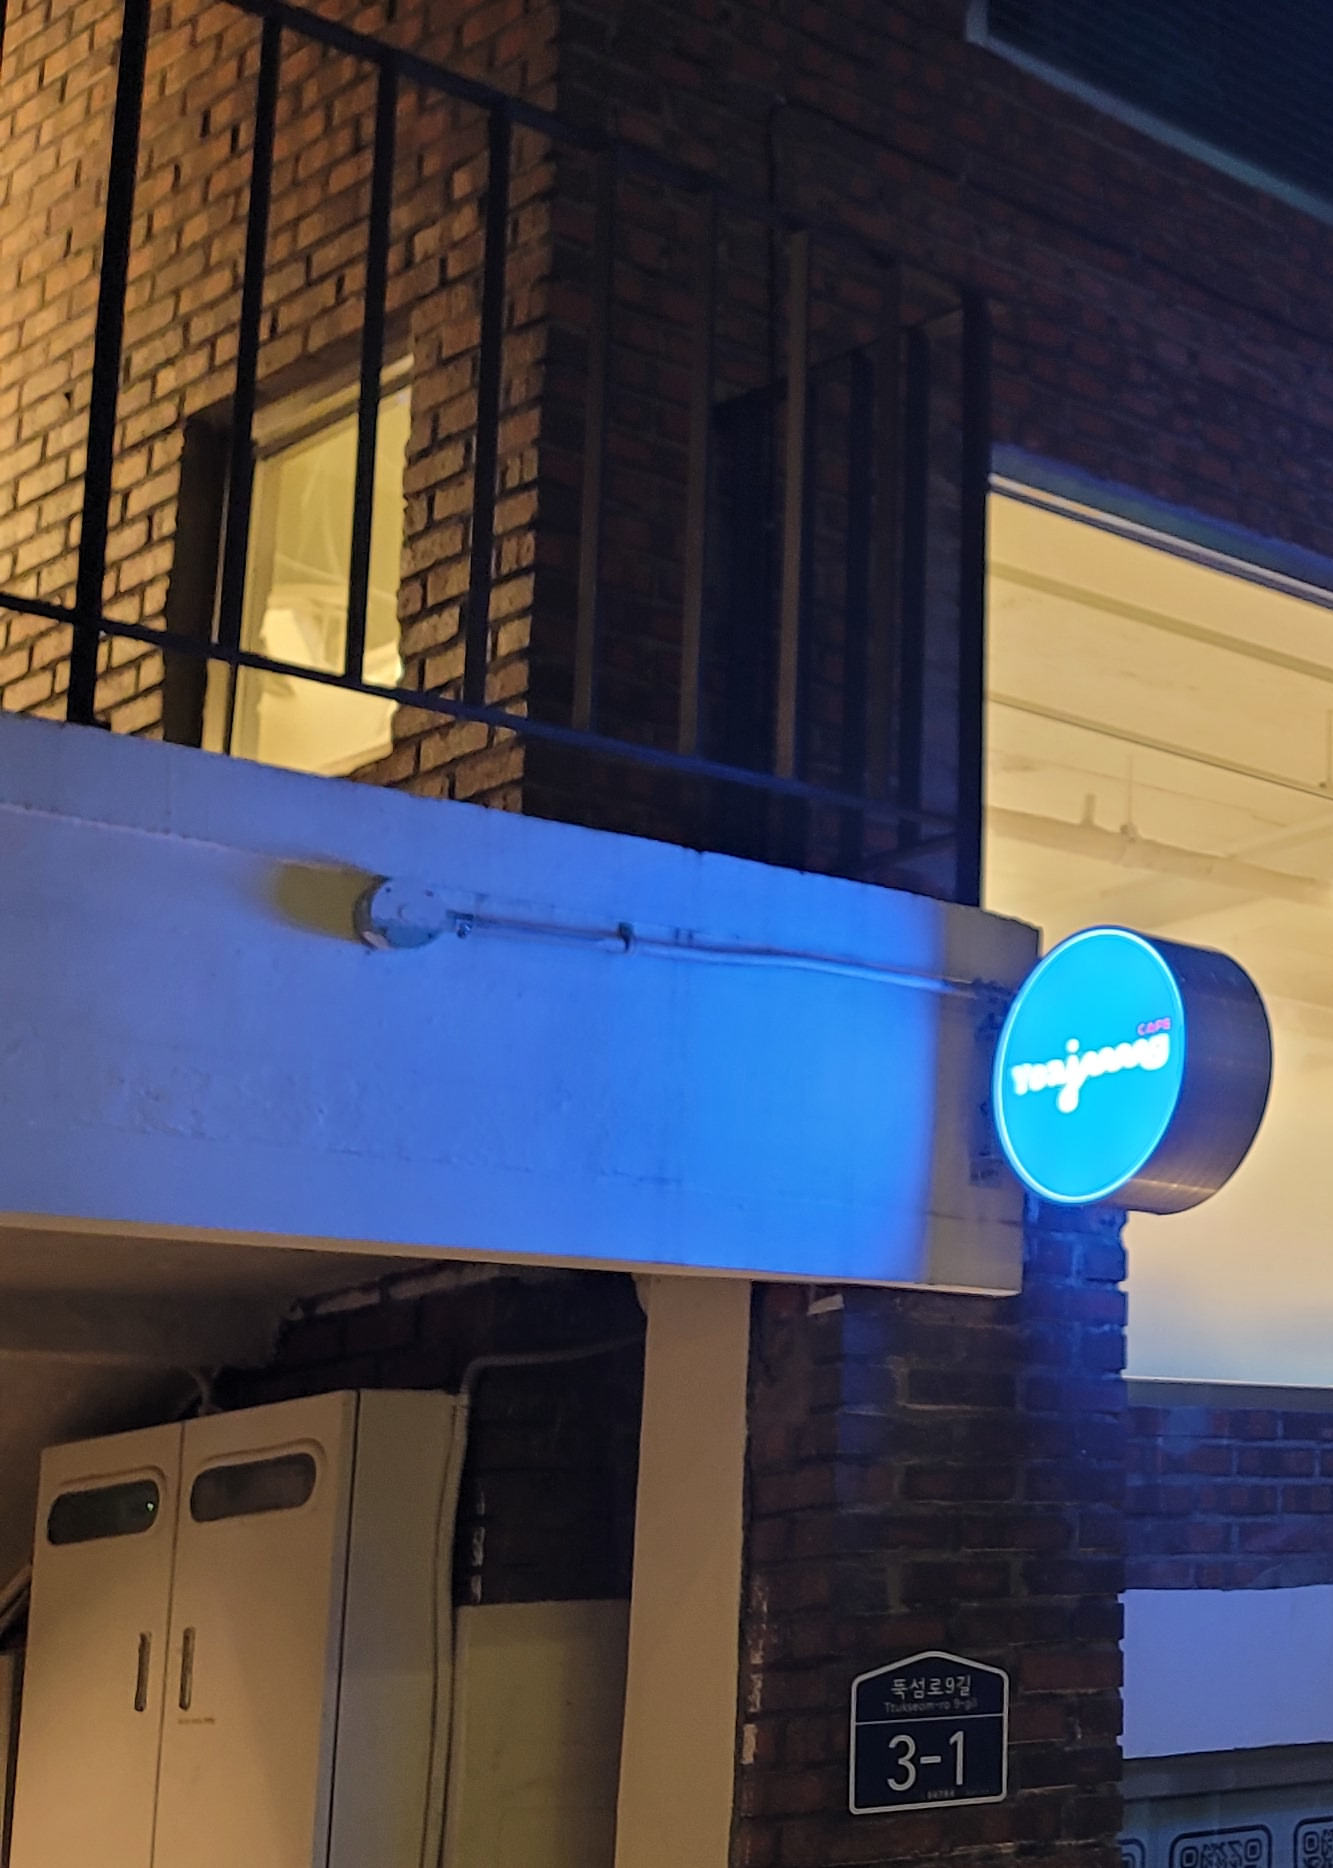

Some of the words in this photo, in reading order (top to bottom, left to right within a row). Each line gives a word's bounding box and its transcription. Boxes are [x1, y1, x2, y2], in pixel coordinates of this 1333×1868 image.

[1137, 1017, 1172, 1036] CAFE
[890, 1675, 972, 1700] 뚝섬로9길
[887, 1730, 965, 1792] 3-1
